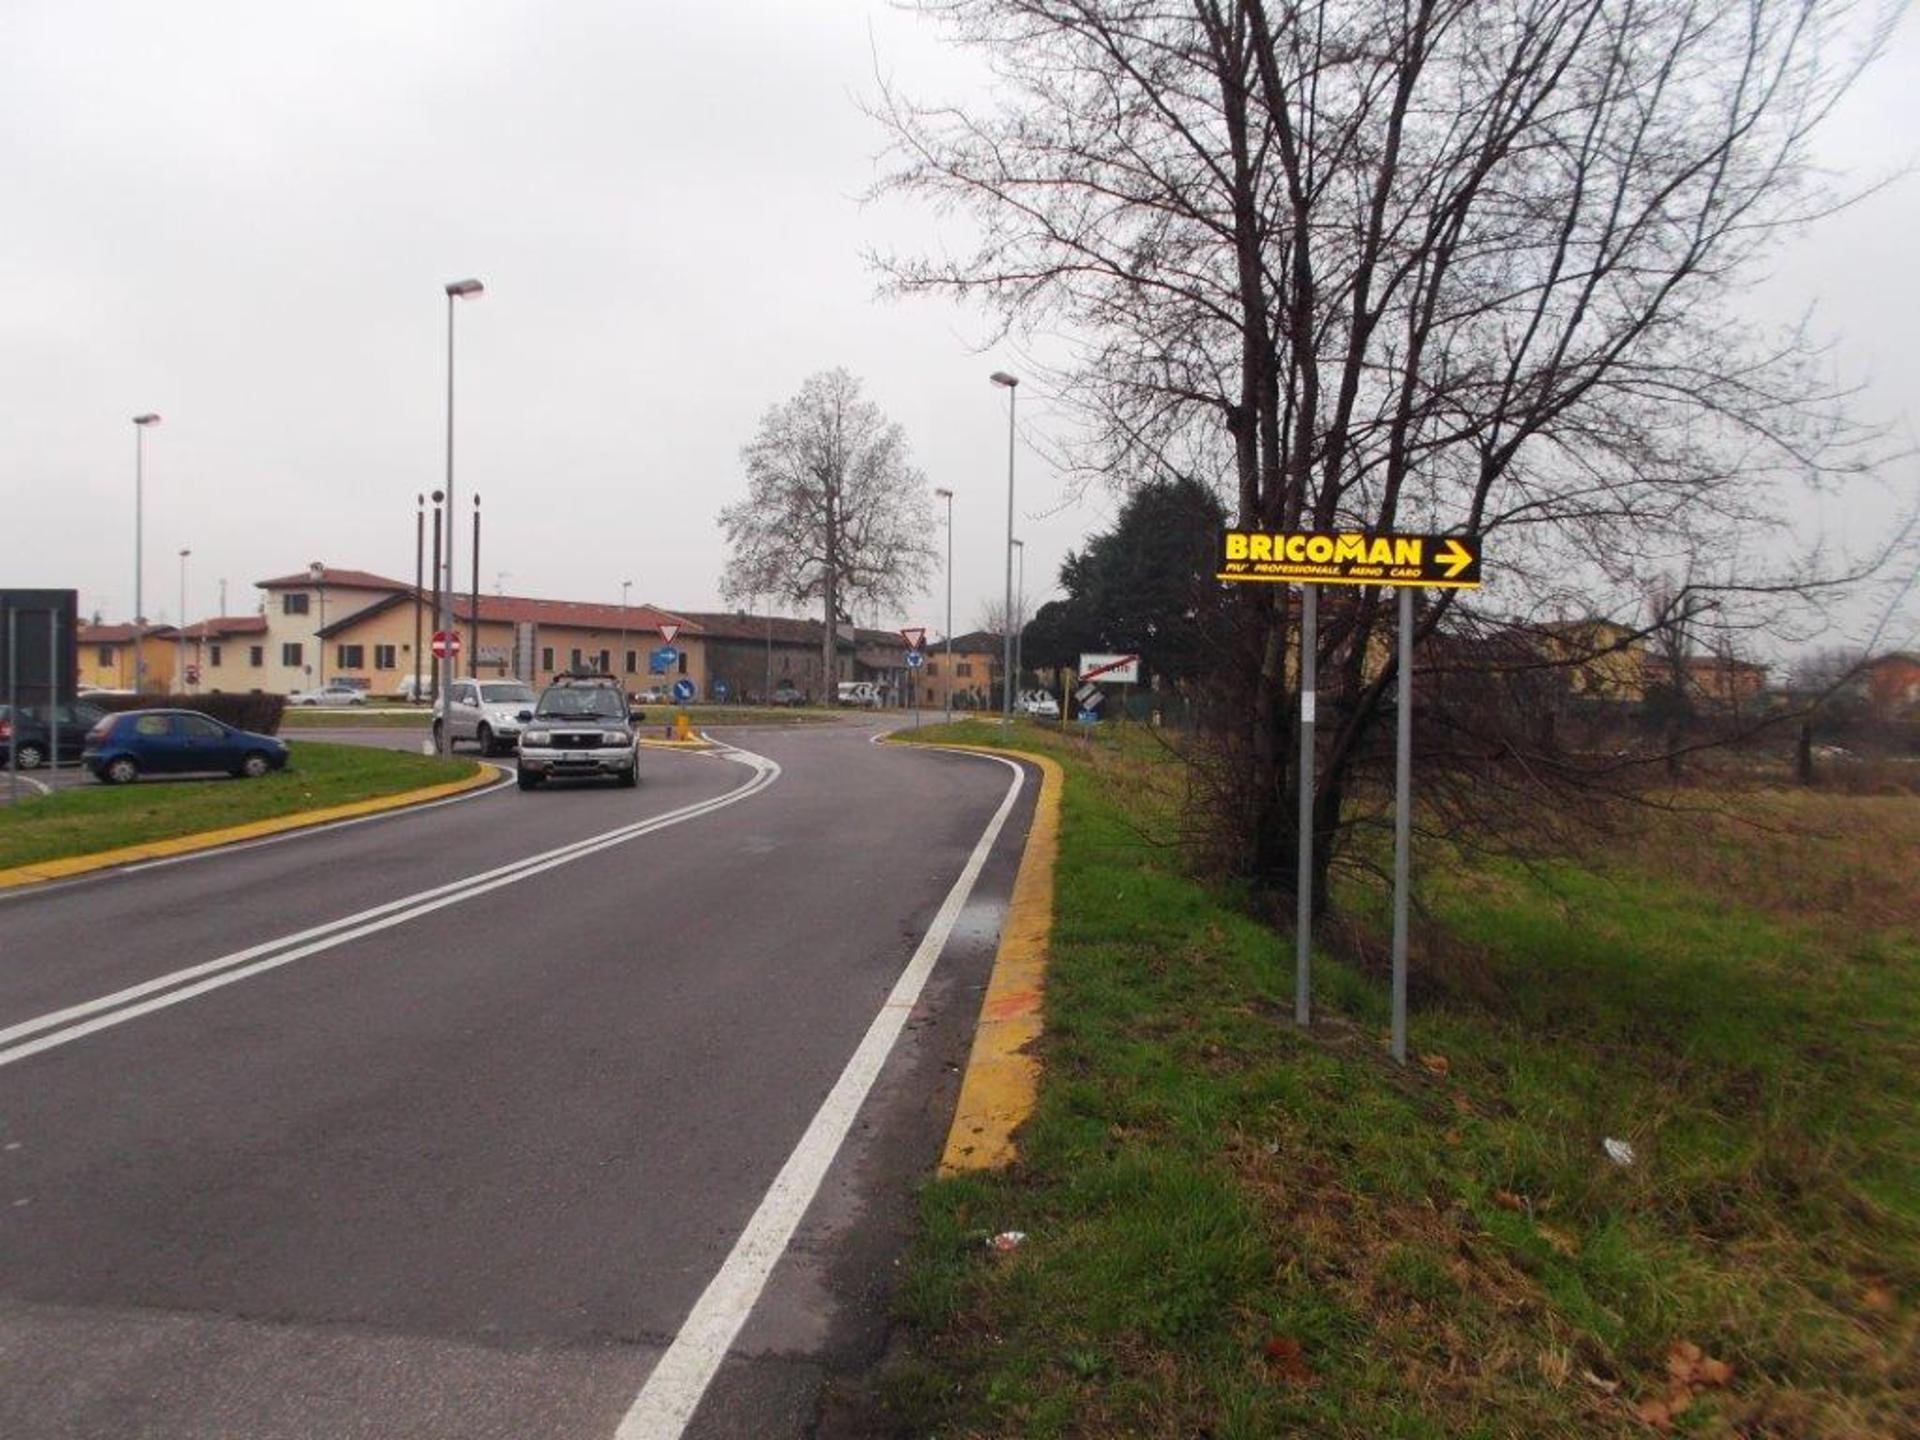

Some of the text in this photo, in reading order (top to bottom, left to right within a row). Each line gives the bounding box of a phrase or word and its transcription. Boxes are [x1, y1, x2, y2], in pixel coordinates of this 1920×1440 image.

[1226, 533, 1422, 565] BRICOMAN
[1254, 563, 1341, 575] PROFESSIONALE
[1349, 566, 1383, 577] MENO
[1390, 568, 1422, 578] CARO
